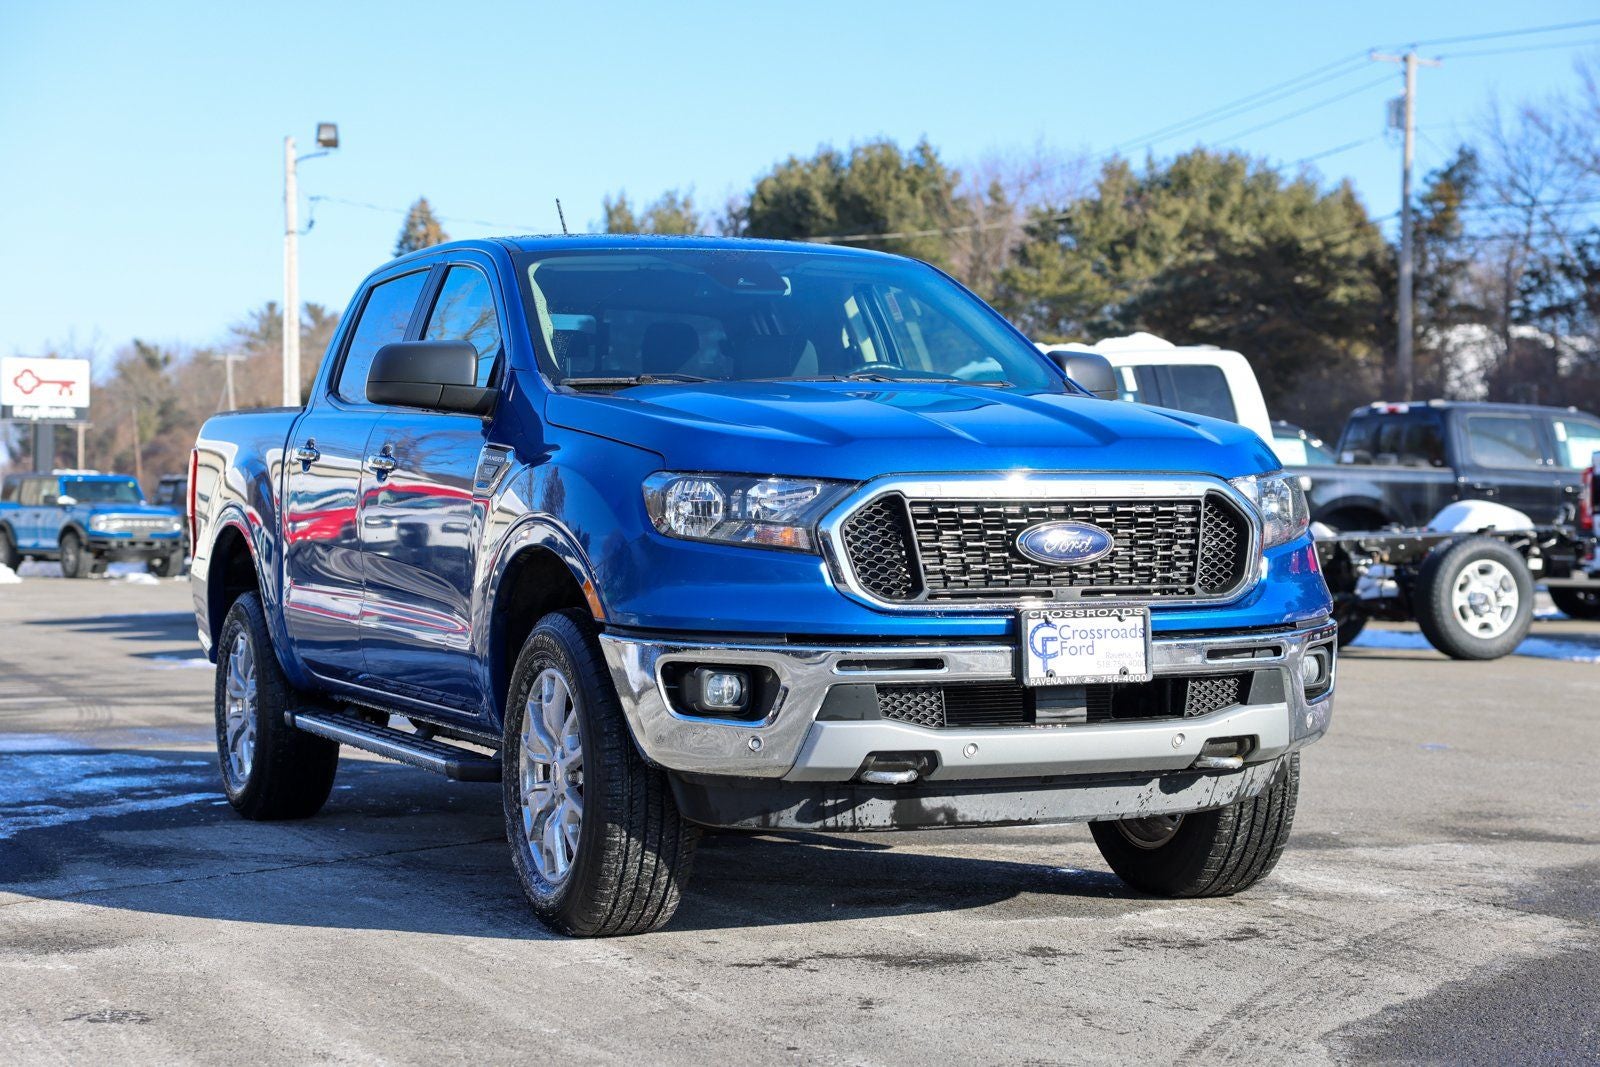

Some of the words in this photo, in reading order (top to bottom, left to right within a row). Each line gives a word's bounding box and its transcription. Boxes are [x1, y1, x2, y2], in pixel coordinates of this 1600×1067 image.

[483, 454, 505, 462] RANGER
[1043, 530, 1093, 553] Ford
[1029, 608, 1144, 618] CROSSROADS
[1058, 624, 1145, 640] Crossroads
[1060, 640, 1095, 656] Ford
[1102, 675, 1147, 683] 756-4000
